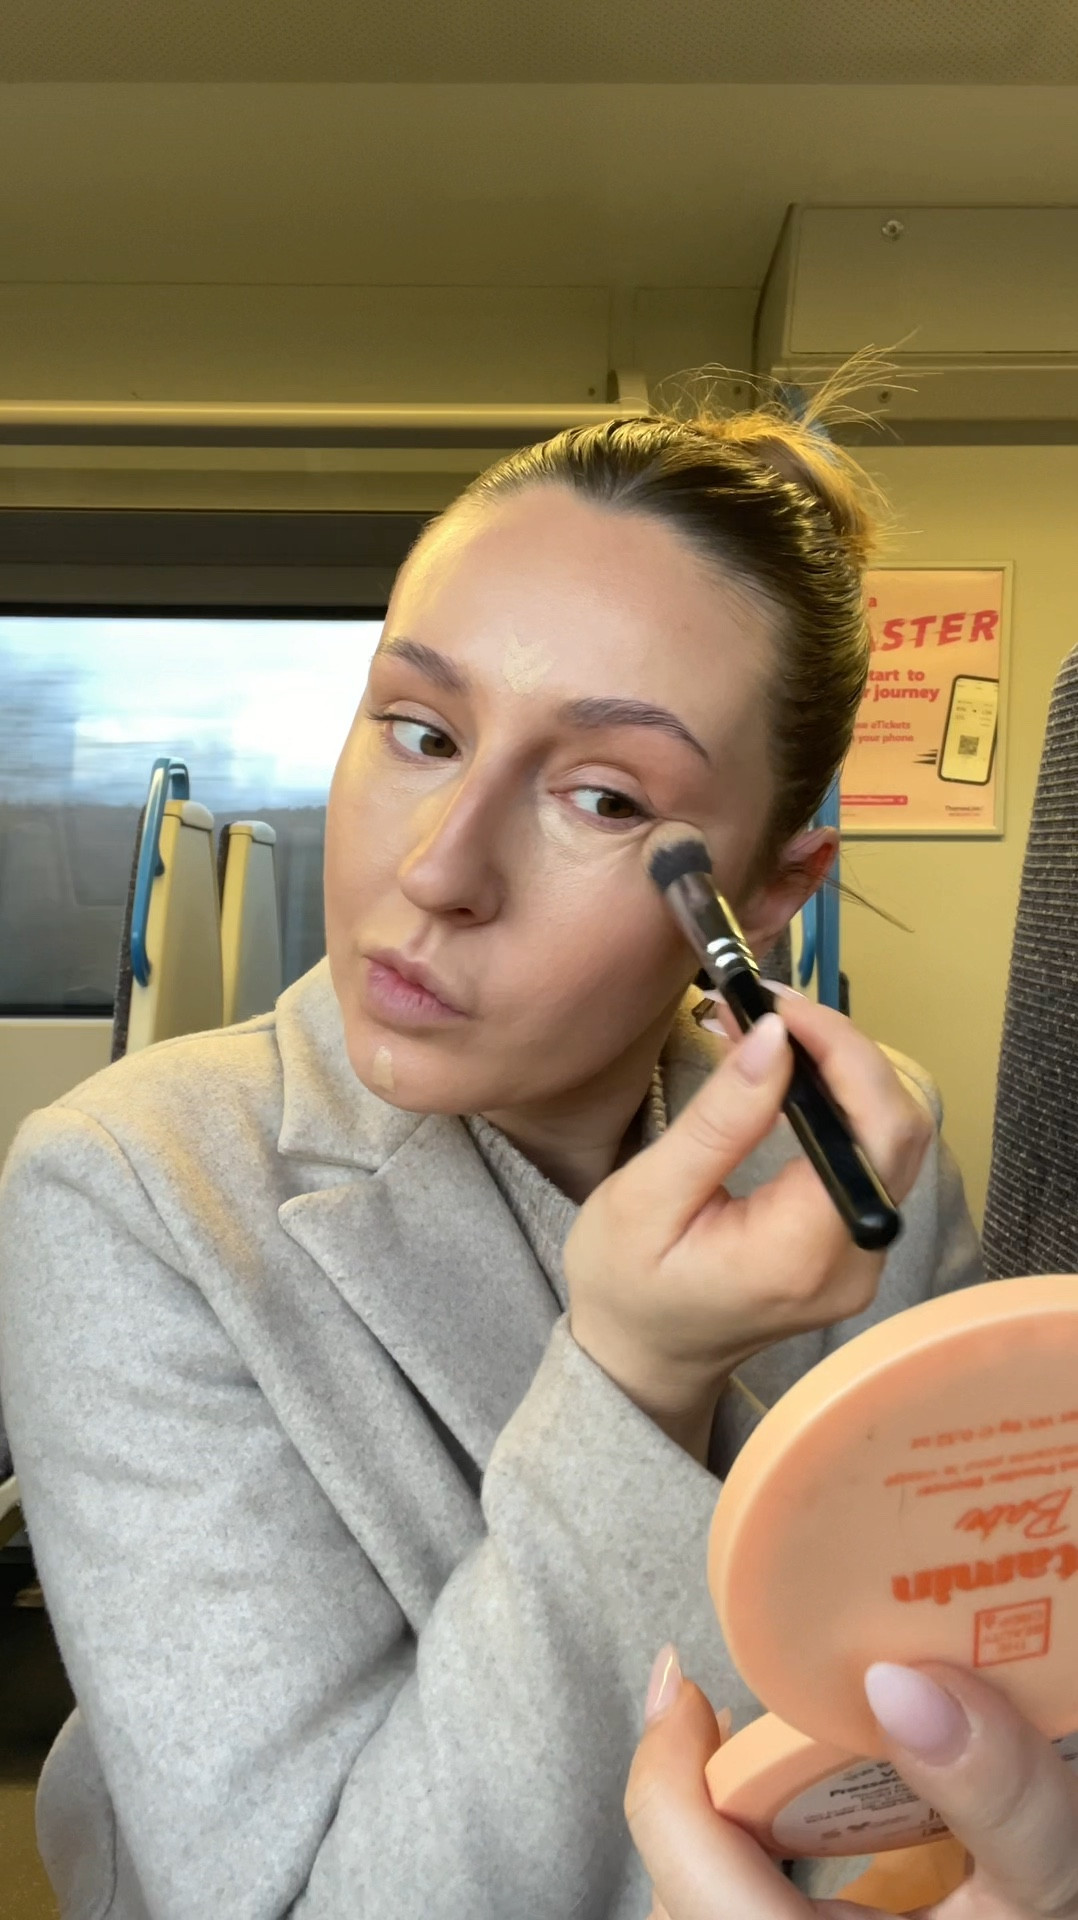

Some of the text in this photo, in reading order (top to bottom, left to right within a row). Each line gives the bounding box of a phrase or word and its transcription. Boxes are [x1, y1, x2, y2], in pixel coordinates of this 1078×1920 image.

[868, 596, 877, 607] a
[870, 609, 999, 653] STER
[869, 669, 925, 682] tart to
[873, 686, 940, 703] journey
[858, 734, 880, 744] your
[882, 733, 914, 745] phone
[954, 1486, 1073, 1541] Babe
[891, 1543, 1078, 1605] tamin
